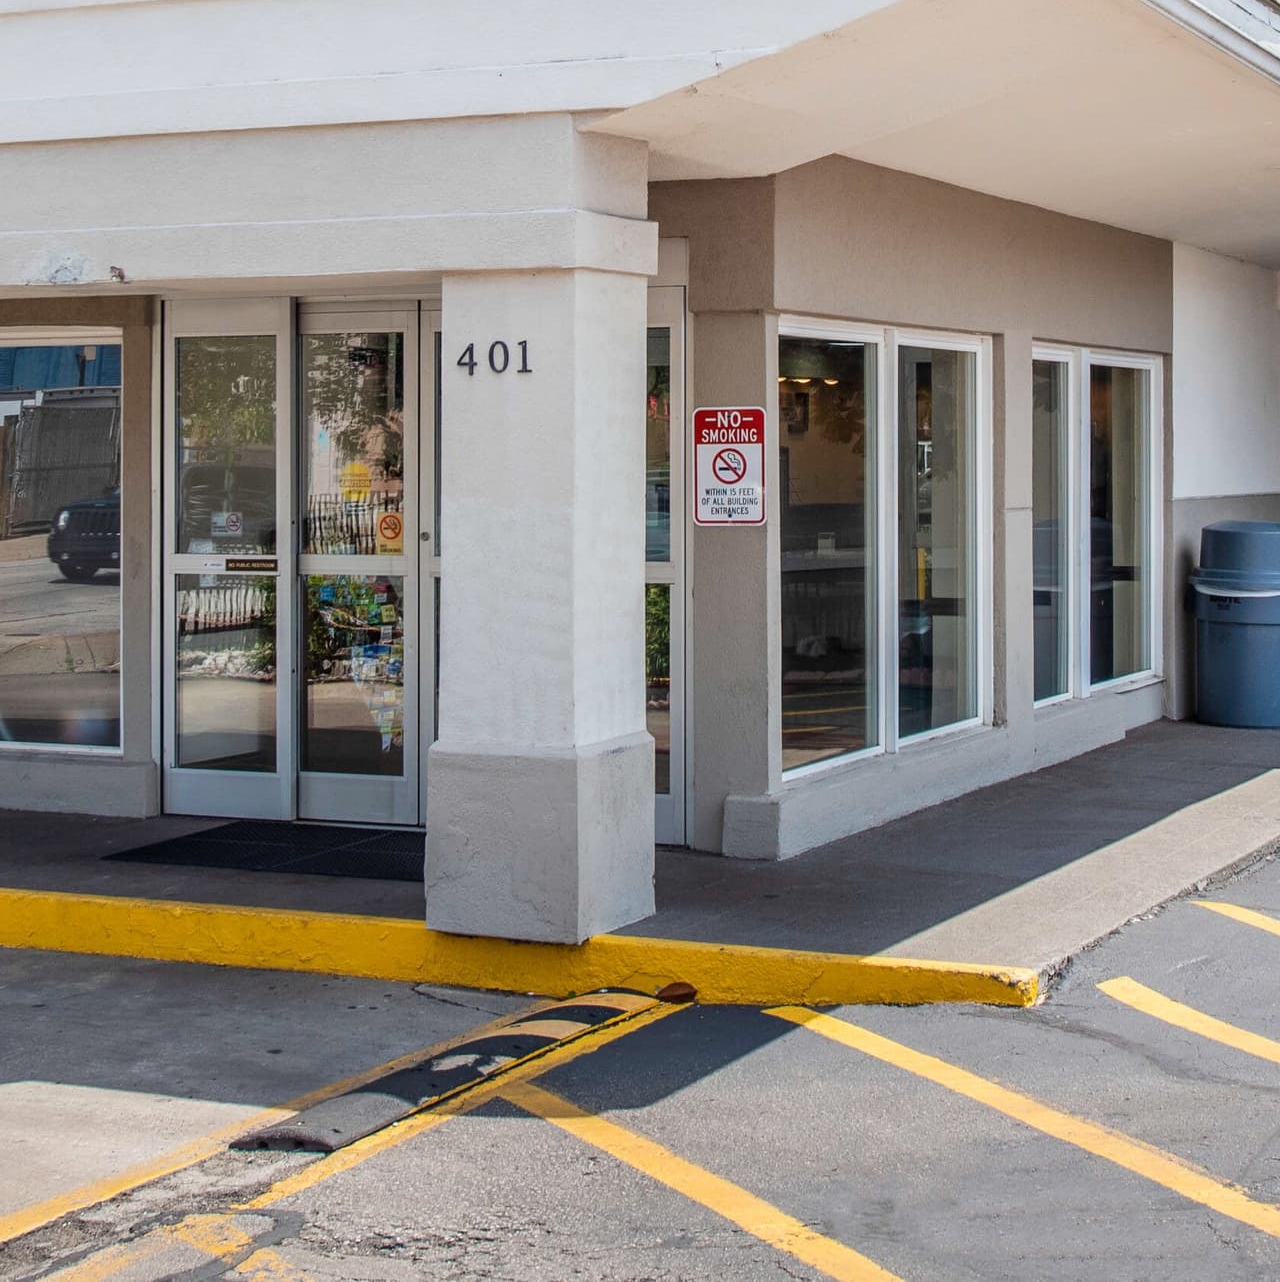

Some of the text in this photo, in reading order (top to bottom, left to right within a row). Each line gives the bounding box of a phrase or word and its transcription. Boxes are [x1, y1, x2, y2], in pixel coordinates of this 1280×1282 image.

[456, 340, 533, 376] 401
[701, 429, 758, 443] SMOKING
[705, 487, 754, 496] WITHIN 15 FEET
[701, 497, 758, 505] OF ALL BUILDING
[711, 506, 749, 515] ENTRANCES
